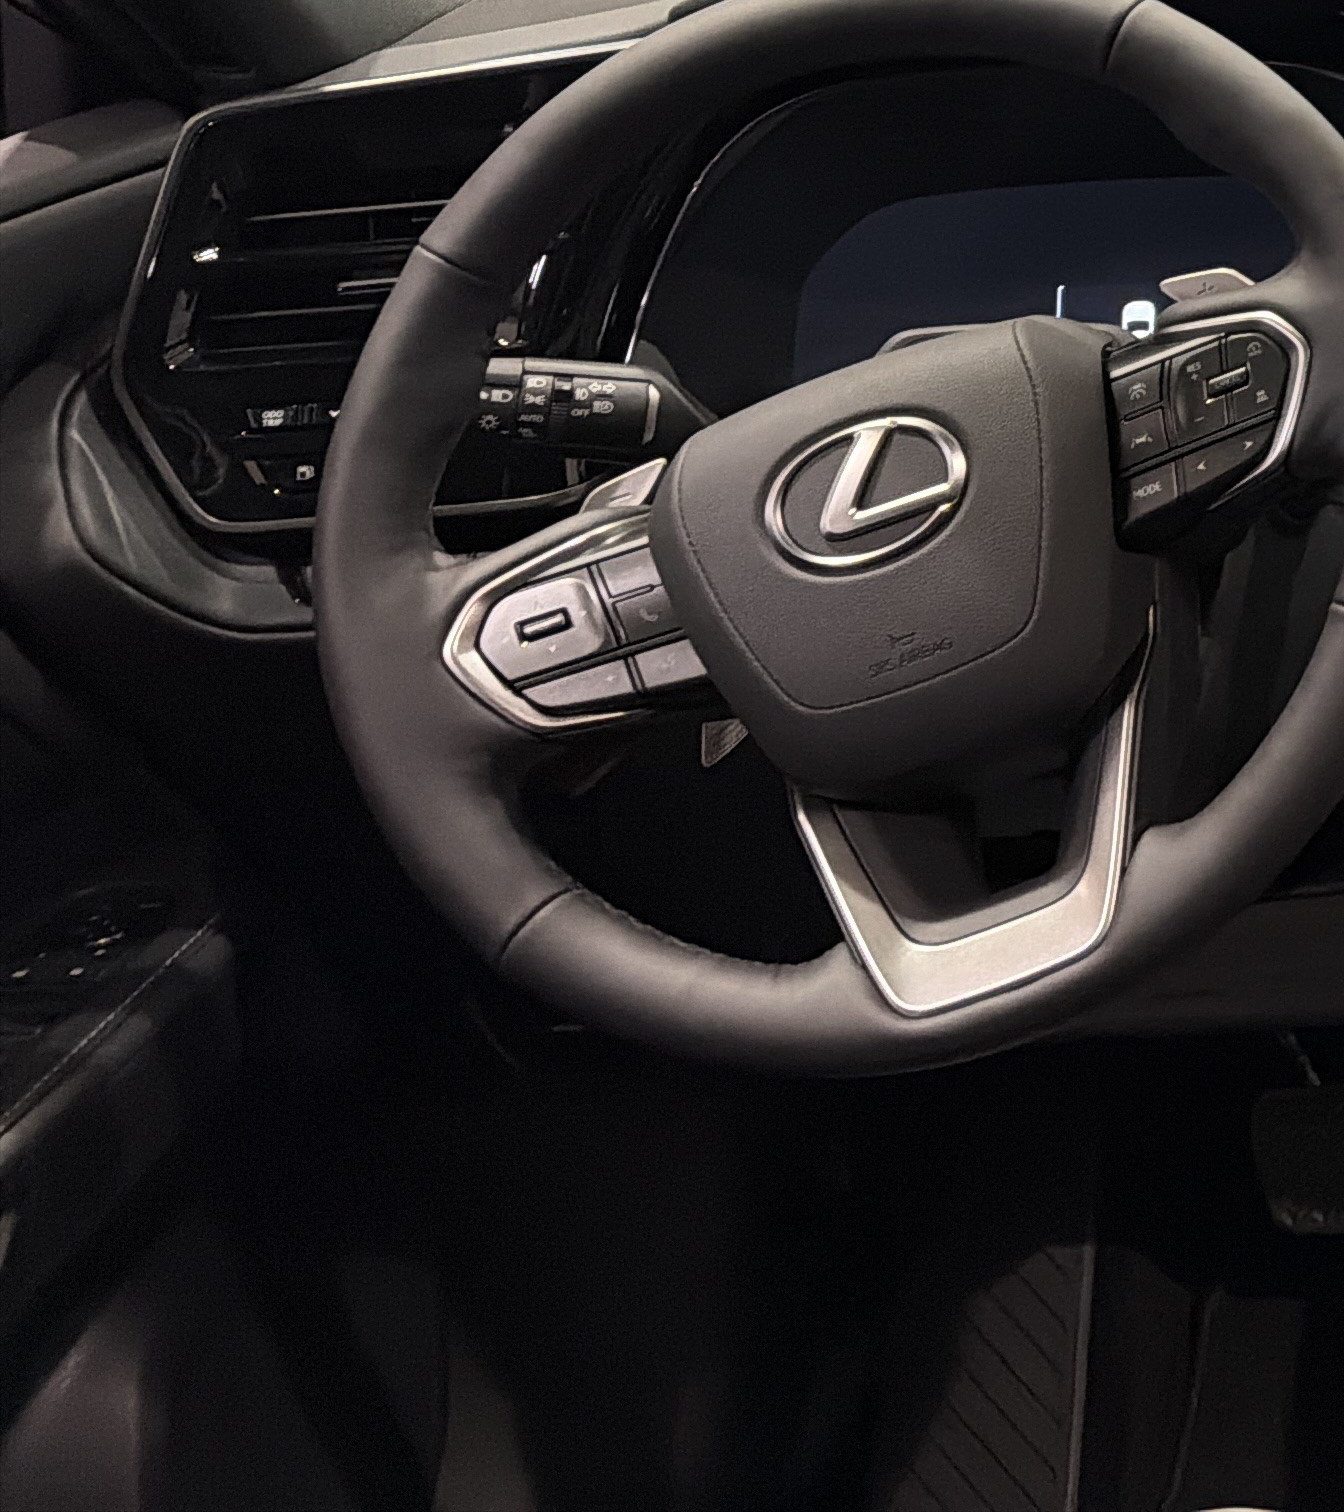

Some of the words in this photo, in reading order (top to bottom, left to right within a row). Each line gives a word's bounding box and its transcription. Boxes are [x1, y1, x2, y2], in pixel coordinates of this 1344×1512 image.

[517, 413, 544, 423] AUTO
[570, 407, 591, 418] OFF
[1132, 481, 1164, 500] MODE
